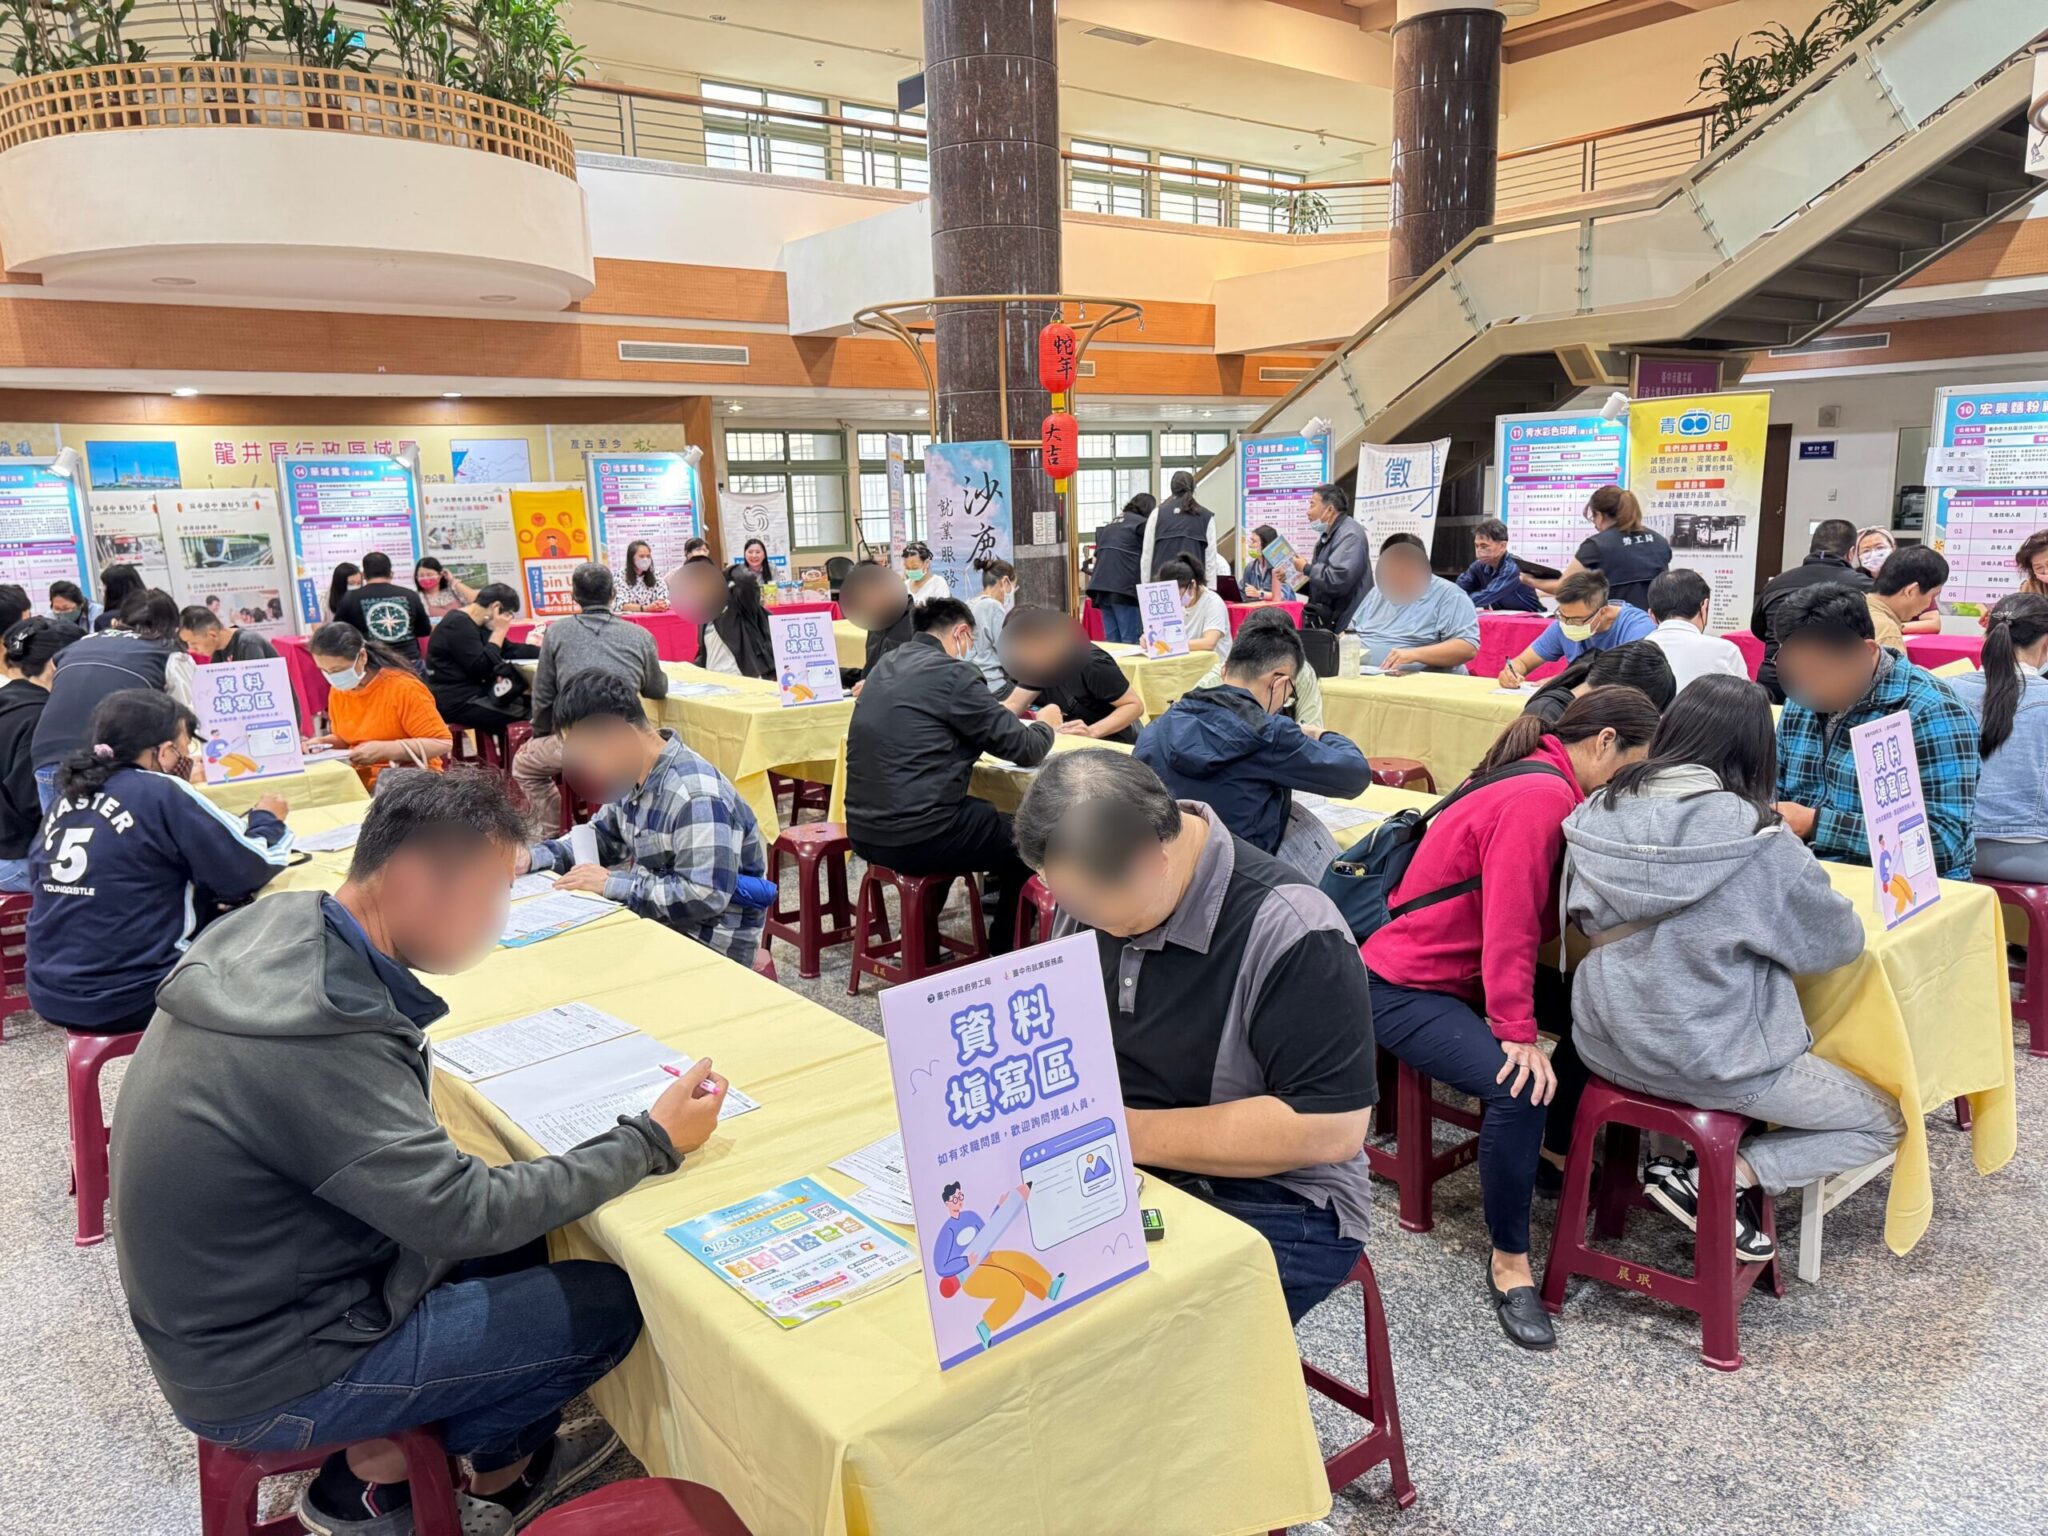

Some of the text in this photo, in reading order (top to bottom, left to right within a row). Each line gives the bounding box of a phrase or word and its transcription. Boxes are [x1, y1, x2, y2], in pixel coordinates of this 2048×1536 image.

[1054, 334, 1073, 380] 蛇年
[1660, 414, 1730, 434] 青 印
[1959, 406, 1973, 416] 10
[1046, 424, 1062, 465] 大吉
[963, 471, 1003, 564] 沙鹿
[937, 498, 959, 589] 就業服務
[1622, 534, 1654, 546] 勞工局
[543, 576, 562, 587] oin
[213, 691, 274, 714] 填寫區
[217, 672, 264, 694] 資料
[936, 956, 1064, 1001] 臺中市政府勞工局 臺中市就業服務處
[951, 984, 1054, 1065] 資料
[946, 1038, 1079, 1129] 填寫區
